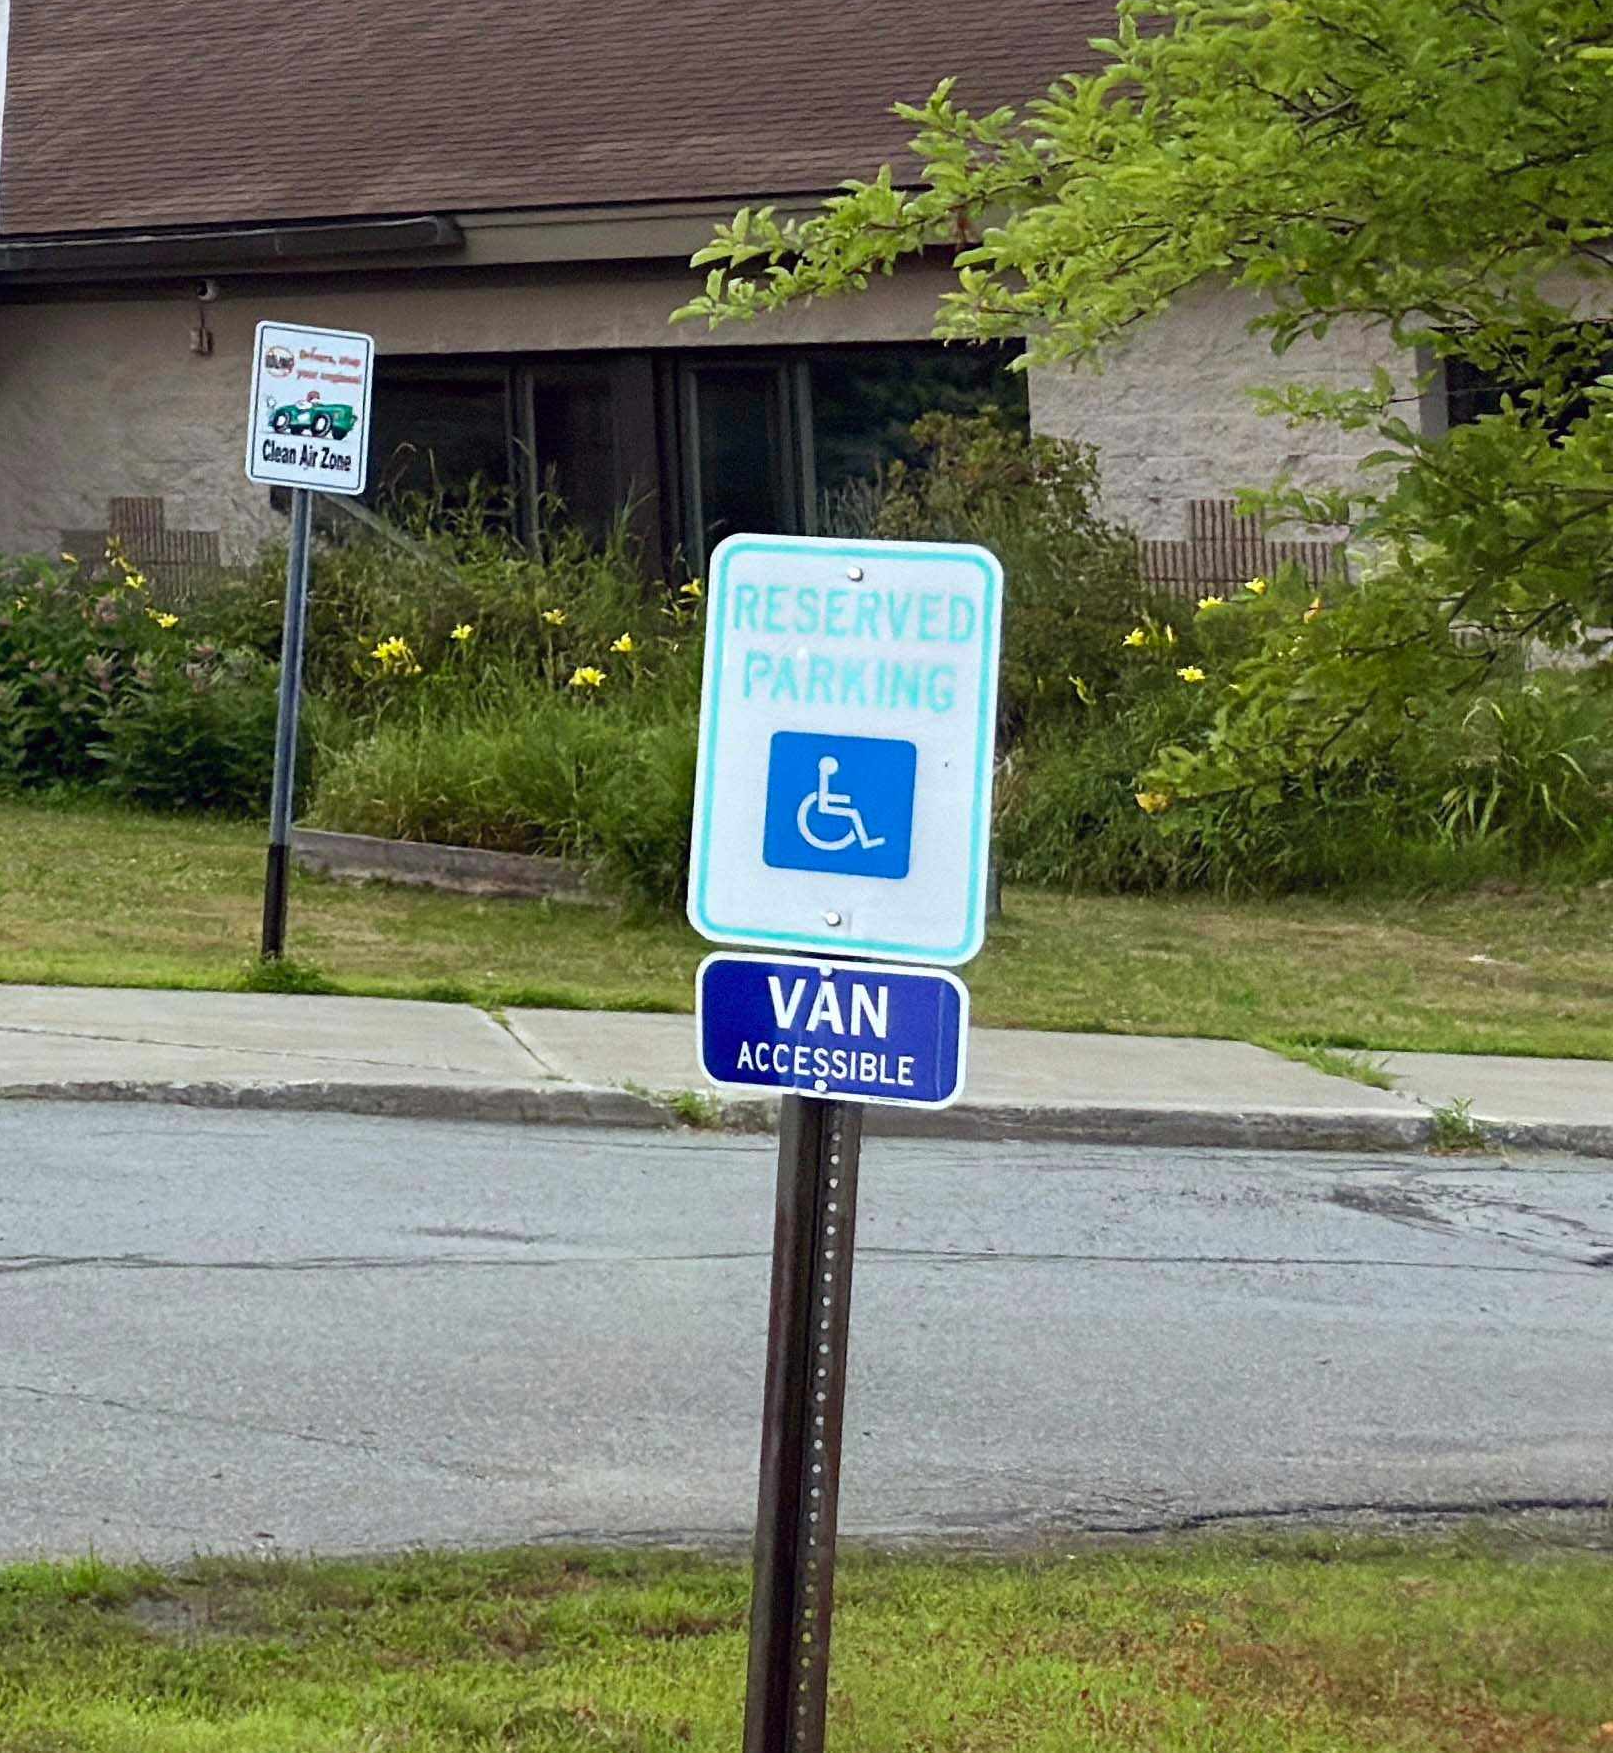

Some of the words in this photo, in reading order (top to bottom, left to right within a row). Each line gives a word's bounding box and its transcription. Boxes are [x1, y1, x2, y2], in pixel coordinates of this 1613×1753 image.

[262, 439, 296, 465] Clean
[299, 445, 318, 470] Air
[320, 447, 352, 472] Zone
[732, 582, 976, 644] RESERVED
[743, 649, 957, 713] PARKING
[767, 975, 889, 1039] VAN
[737, 1040, 916, 1088] ACCESSIBLE
